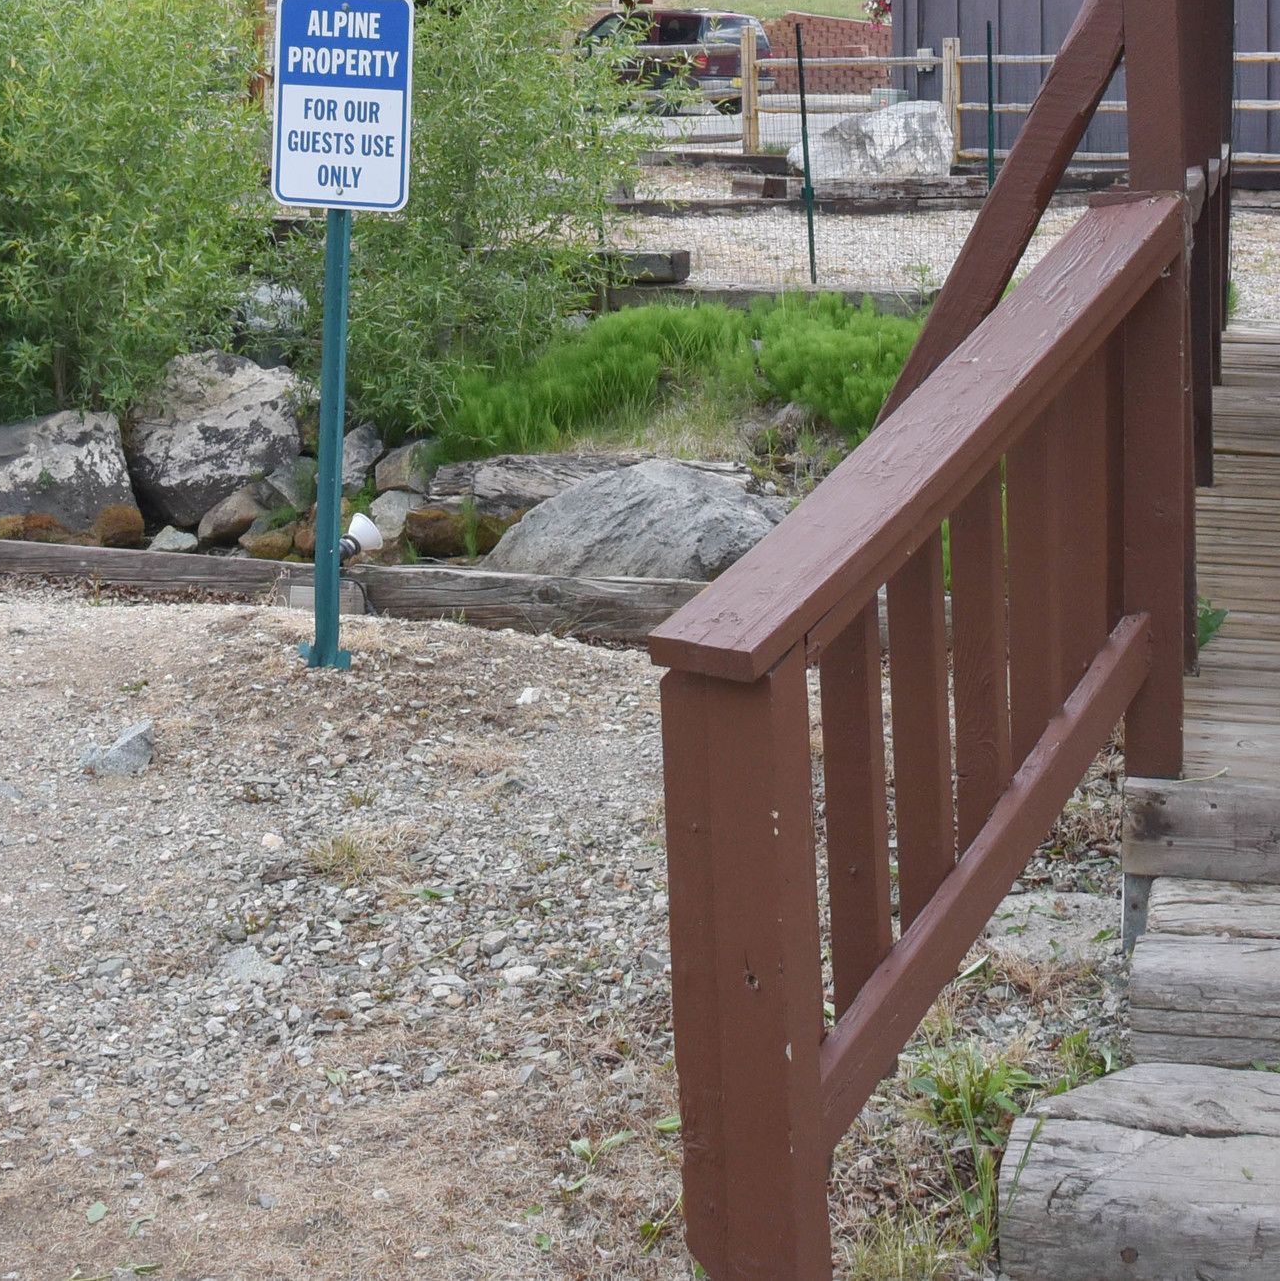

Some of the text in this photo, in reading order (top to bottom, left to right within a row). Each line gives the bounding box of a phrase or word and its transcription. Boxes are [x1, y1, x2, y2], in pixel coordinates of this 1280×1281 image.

[307, 9, 381, 40] ALPINE
[287, 45, 400, 78] PROPERTY
[303, 97, 381, 124] FOR OUR
[287, 129, 395, 158] GUESTS USE
[317, 164, 363, 189] ONLY
